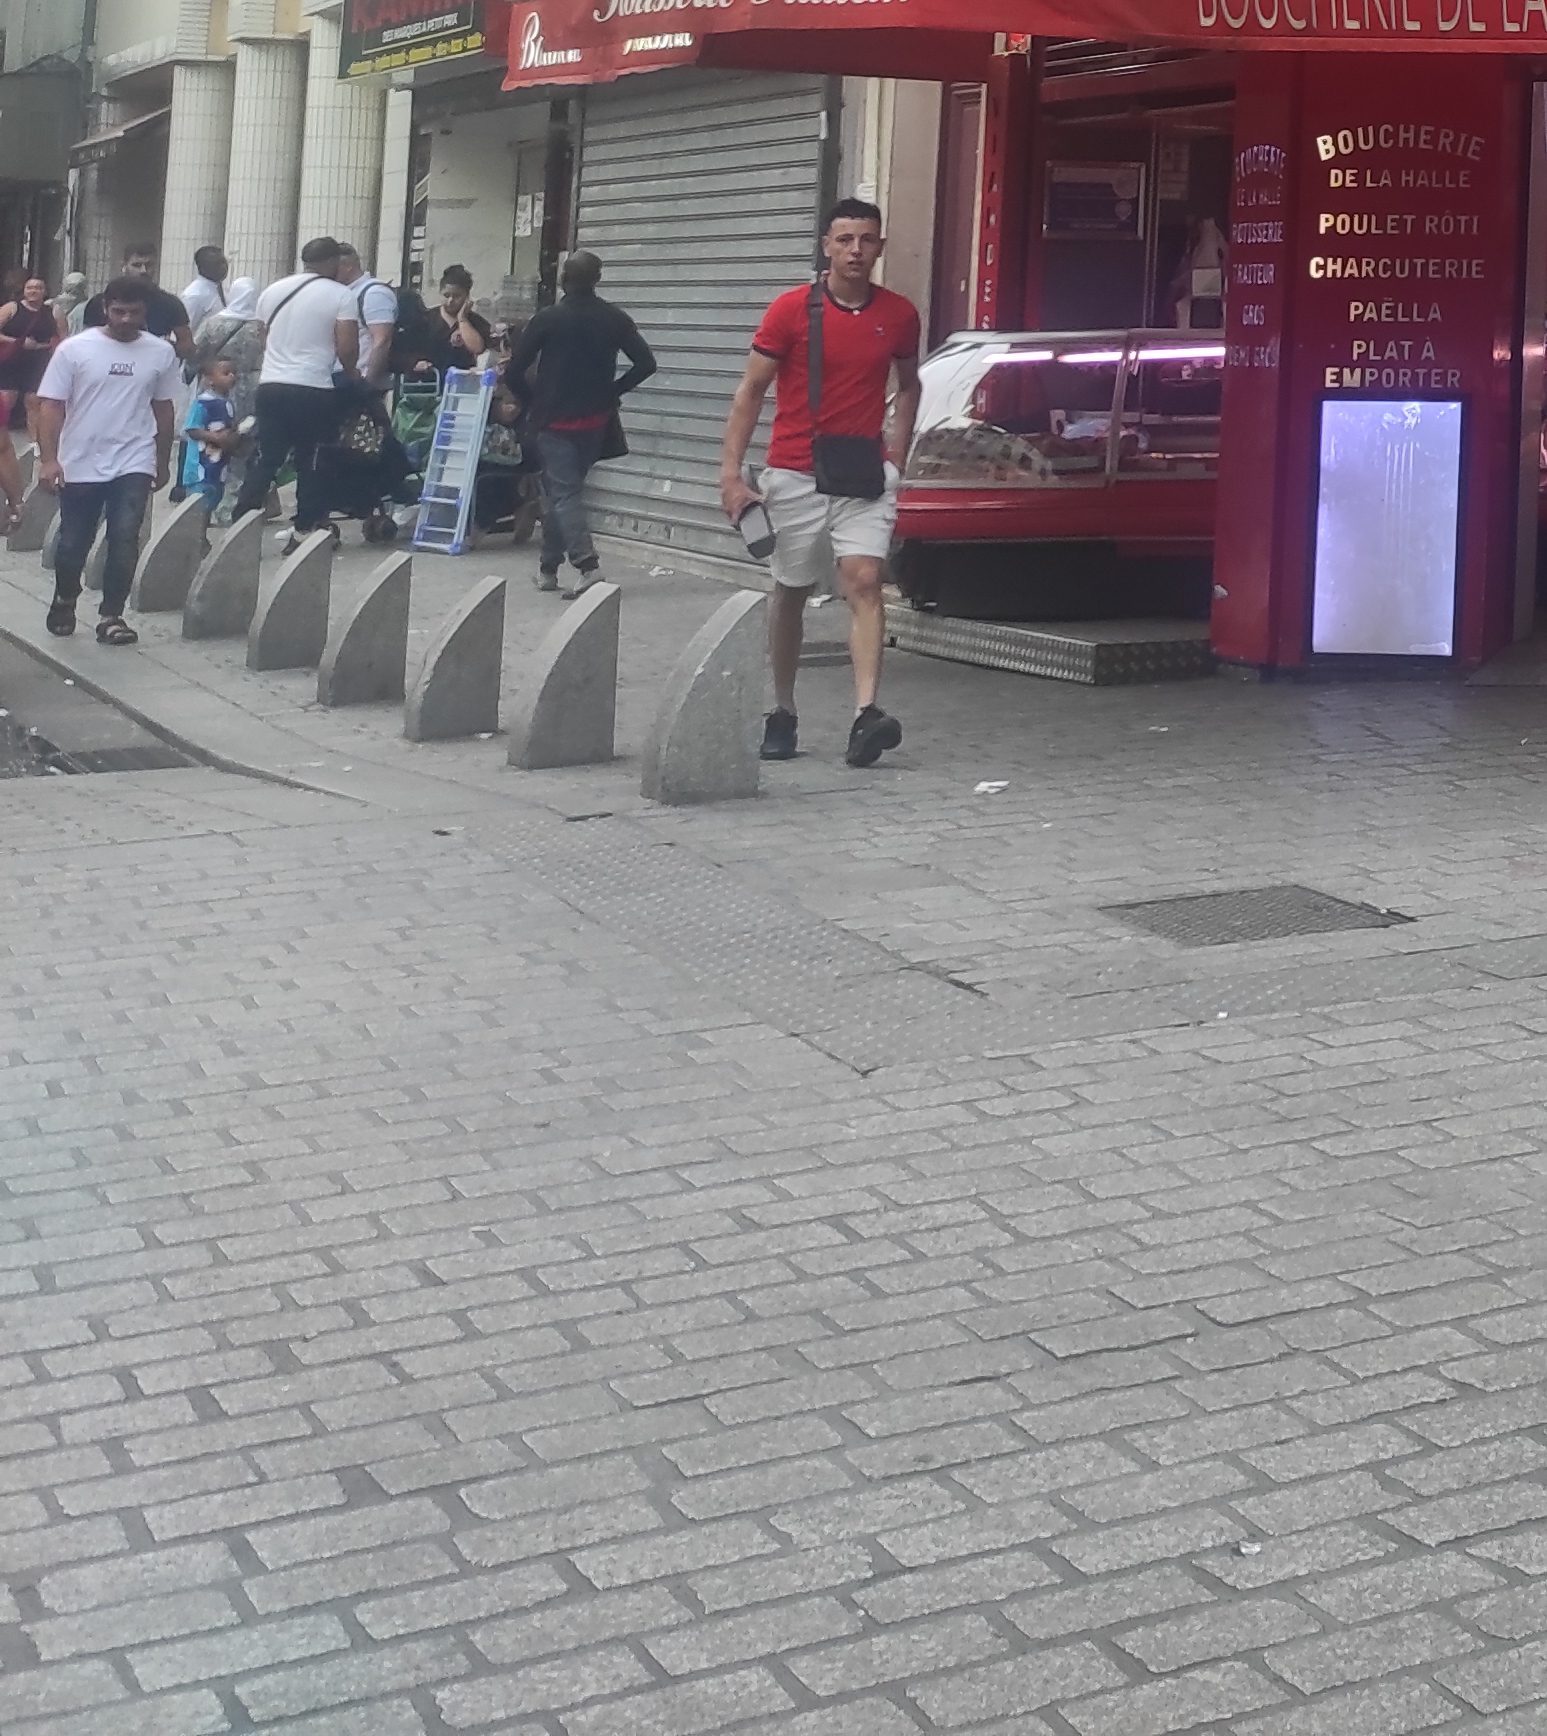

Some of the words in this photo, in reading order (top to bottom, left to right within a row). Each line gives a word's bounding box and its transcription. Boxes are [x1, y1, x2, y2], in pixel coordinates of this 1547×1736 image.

[1316, 124, 1486, 162] BOUCHERIE
[1329, 169, 1358, 188] DE
[1365, 169, 1392, 188] LA
[1400, 169, 1471, 188] HALLE
[1319, 213, 1416, 235] POULET
[1425, 210, 1479, 235] RÔTI
[1309, 257, 1484, 279] CHARCUTERIE
[1242, 304, 1265, 326] GROS
[1349, 297, 1442, 323] PAËLLA
[1352, 340, 1413, 361] PLAT
[1421, 337, 1436, 361] À
[1324, 367, 1461, 388] EMPORTER
